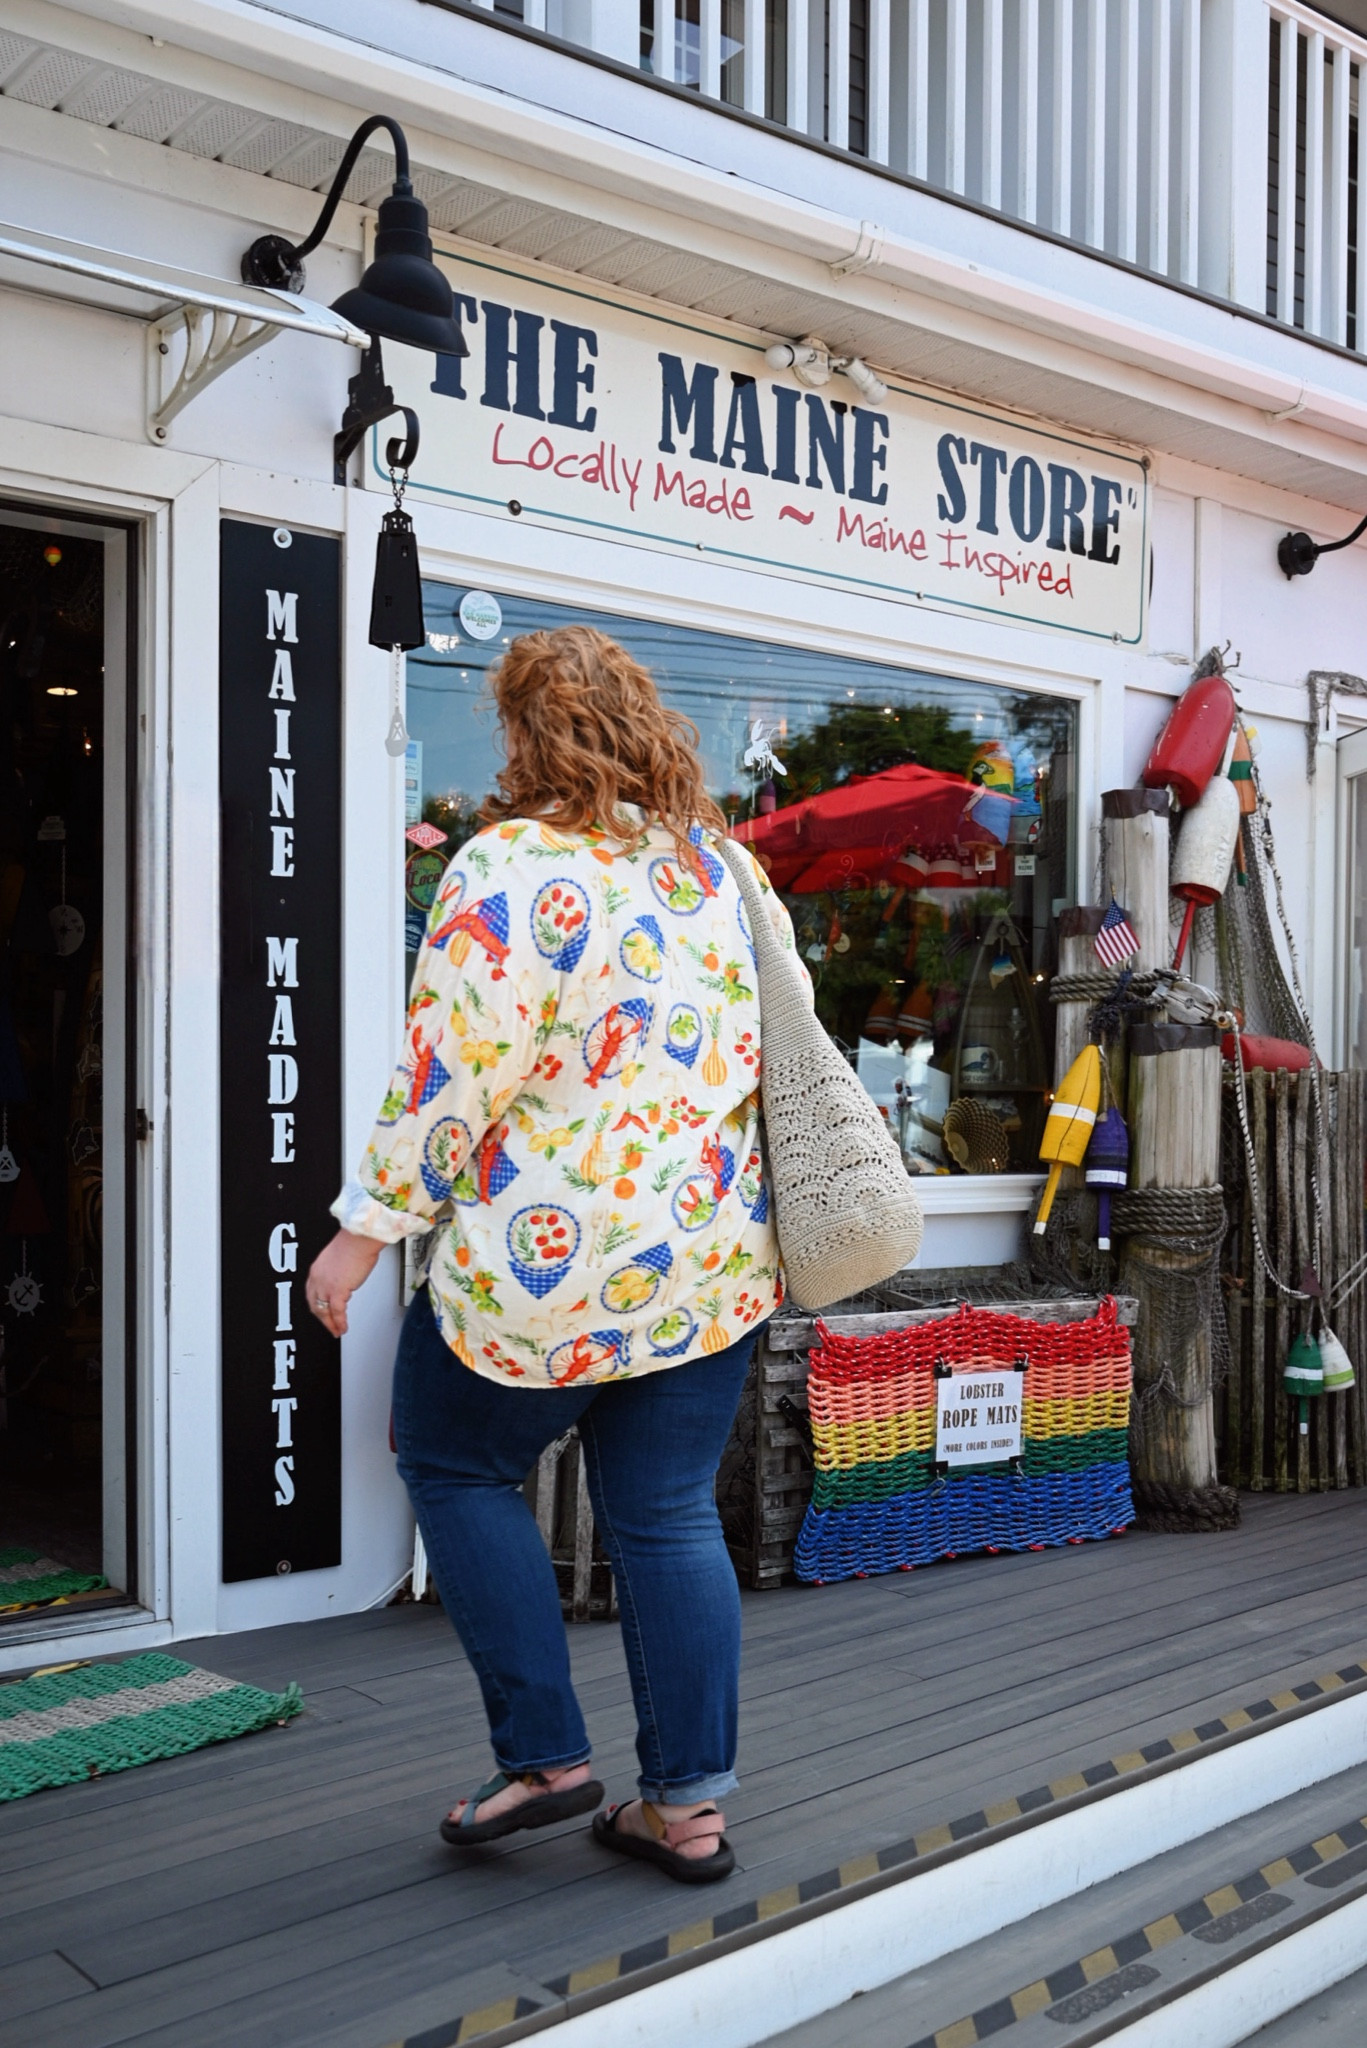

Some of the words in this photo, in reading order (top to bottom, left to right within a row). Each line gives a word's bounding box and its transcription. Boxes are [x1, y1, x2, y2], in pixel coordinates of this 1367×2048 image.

[430, 291, 599, 433] THE
[657, 352, 890, 506] MAINE
[492, 422, 643, 512] Locally
[653, 462, 755, 521] Made
[836, 505, 929, 561] Maine
[936, 528, 1074, 599] Inspired
[265, 589, 299, 877] MAINE
[409, 869, 441, 888] Loca
[265, 936, 299, 1163] MADE
[268, 1222, 299, 1506] GIFTS
[942, 1408, 978, 1429] ROPE
[986, 1405, 1018, 1426] MATS
[960, 1382, 1005, 1400] LOBSTER
[966, 1441, 988, 1452] COLORS
